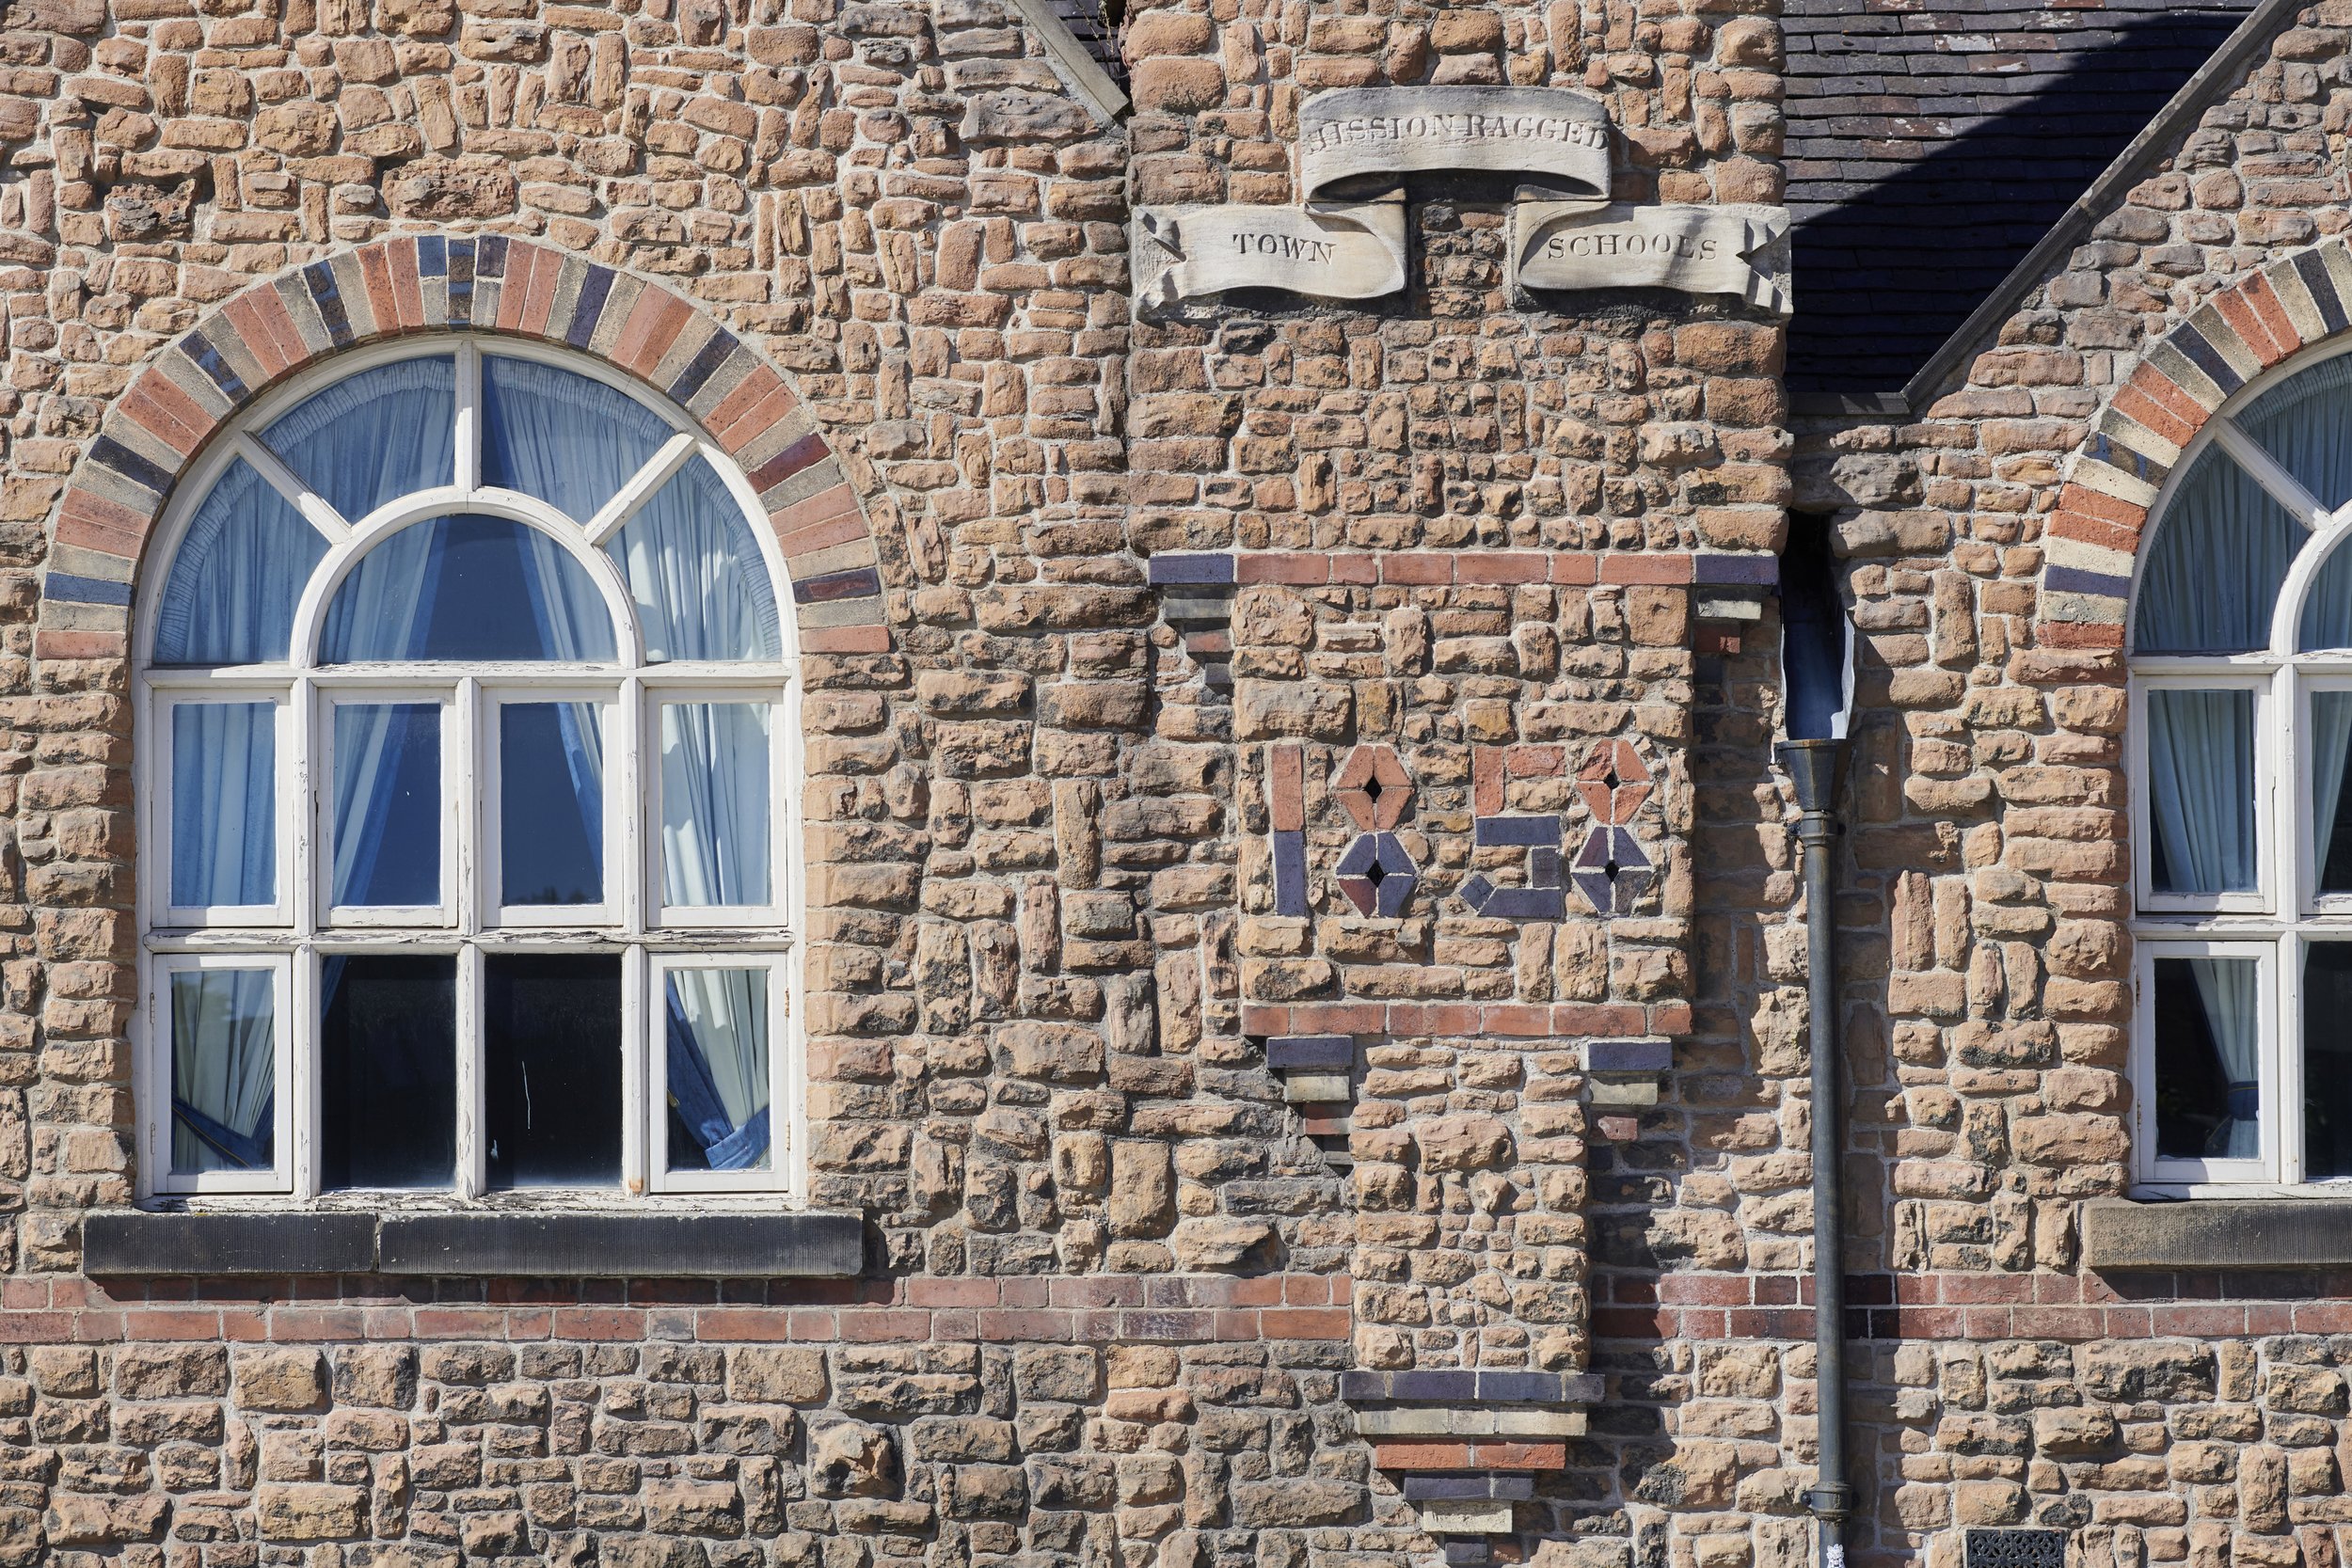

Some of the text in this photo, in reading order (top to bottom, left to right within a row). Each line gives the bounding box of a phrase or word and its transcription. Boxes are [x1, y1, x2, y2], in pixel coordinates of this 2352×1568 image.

[1464, 114, 1609, 150] RAGGED
[1232, 234, 1337, 265] TOWN
[1548, 233, 1718, 261] SCHOOLS
[1271, 738, 1653, 917] 1858
